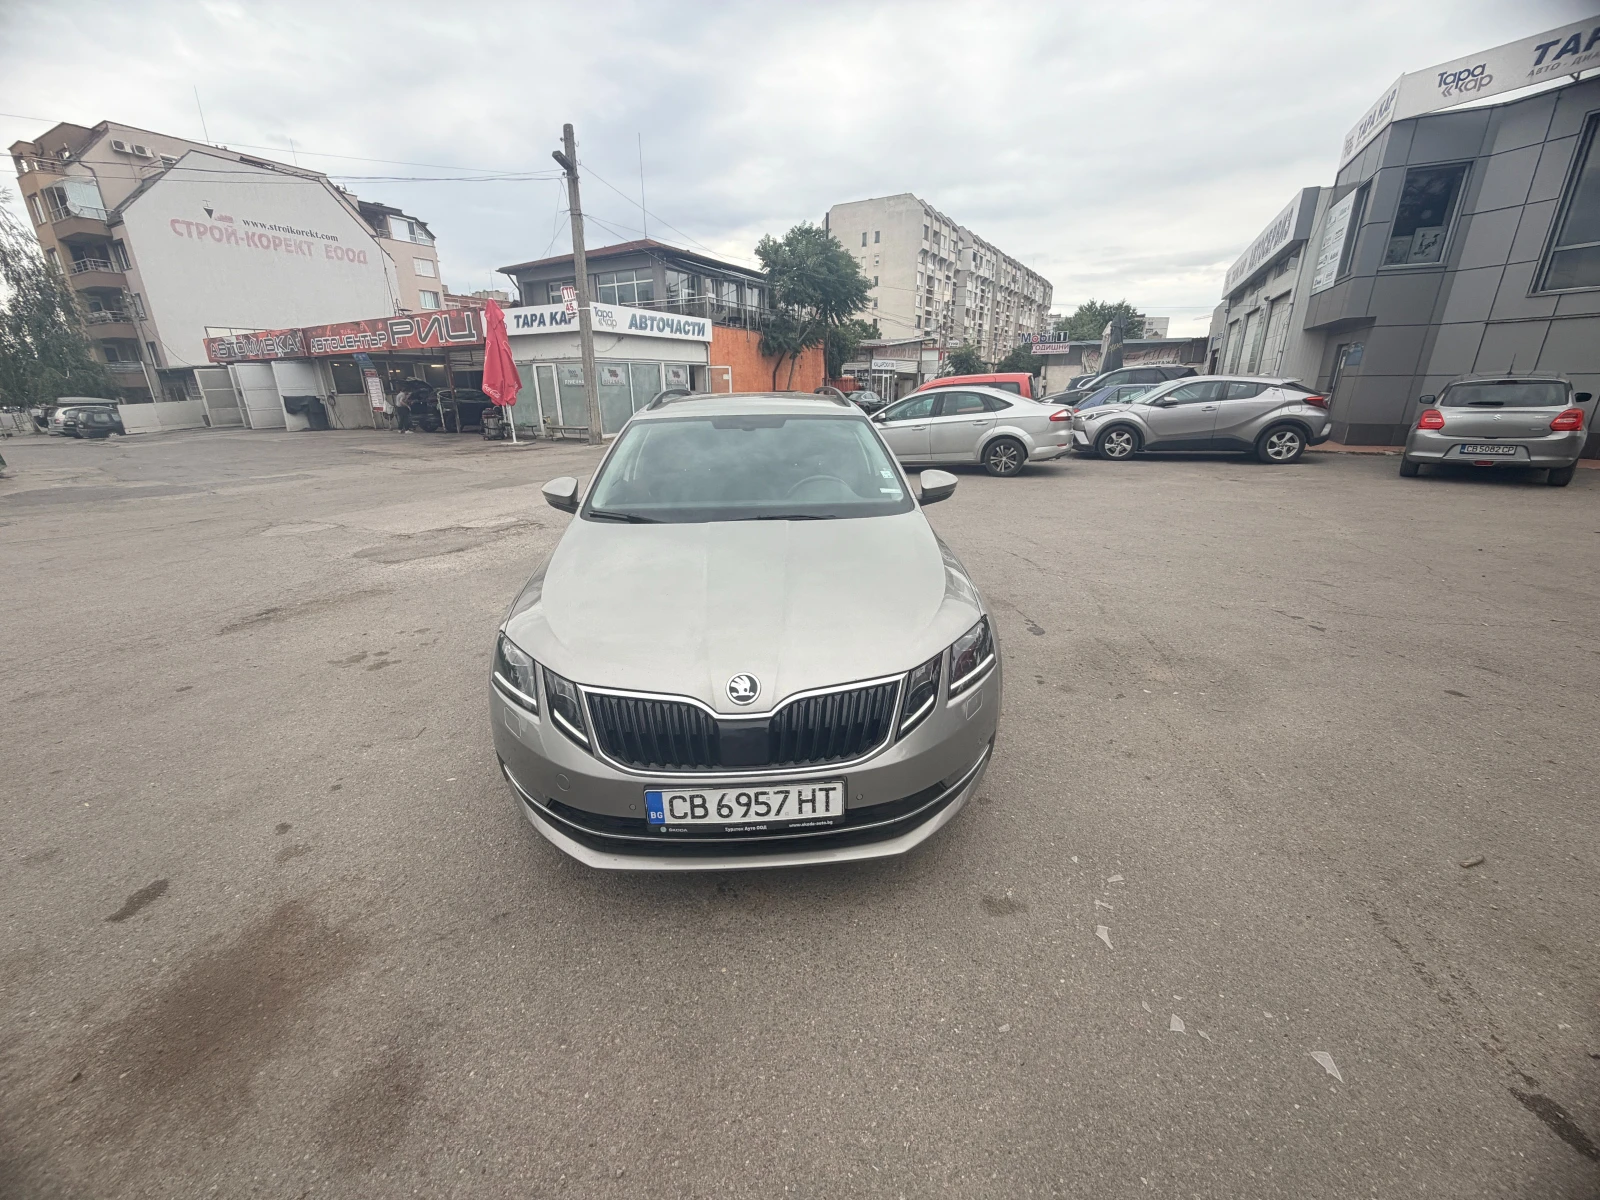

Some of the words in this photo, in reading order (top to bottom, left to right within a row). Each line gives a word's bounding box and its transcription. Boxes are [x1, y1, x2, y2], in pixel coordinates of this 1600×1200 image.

[1438, 63, 1487, 89] Тара
[1526, 62, 1560, 78] АВТО
[1357, 109, 1377, 141] ТАРА
[1376, 88, 1397, 122] КАР
[170, 218, 314, 257] СТРОЙ-КОРЕКТ
[324, 243, 368, 264] ЕООД
[242, 218, 339, 242] www.stroikorekt.com
[566, 303, 574, 312] 45
[593, 306, 613, 321] Тара
[387, 311, 477, 346] РИЦ
[514, 312, 546, 328] ТАРА
[628, 313, 706, 337] АВТОЧАСТИ
[210, 335, 299, 358] АВТОМИВКА
[311, 331, 387, 353] АВТОЦЕНТЪР
[1020, 331, 1056, 343] Mobil
[1479, 445, 1500, 453] 5082
[668, 794, 709, 819] CB
[716, 790, 790, 819] 6957
[798, 786, 837, 815] HT
[650, 811, 663, 819] BG
